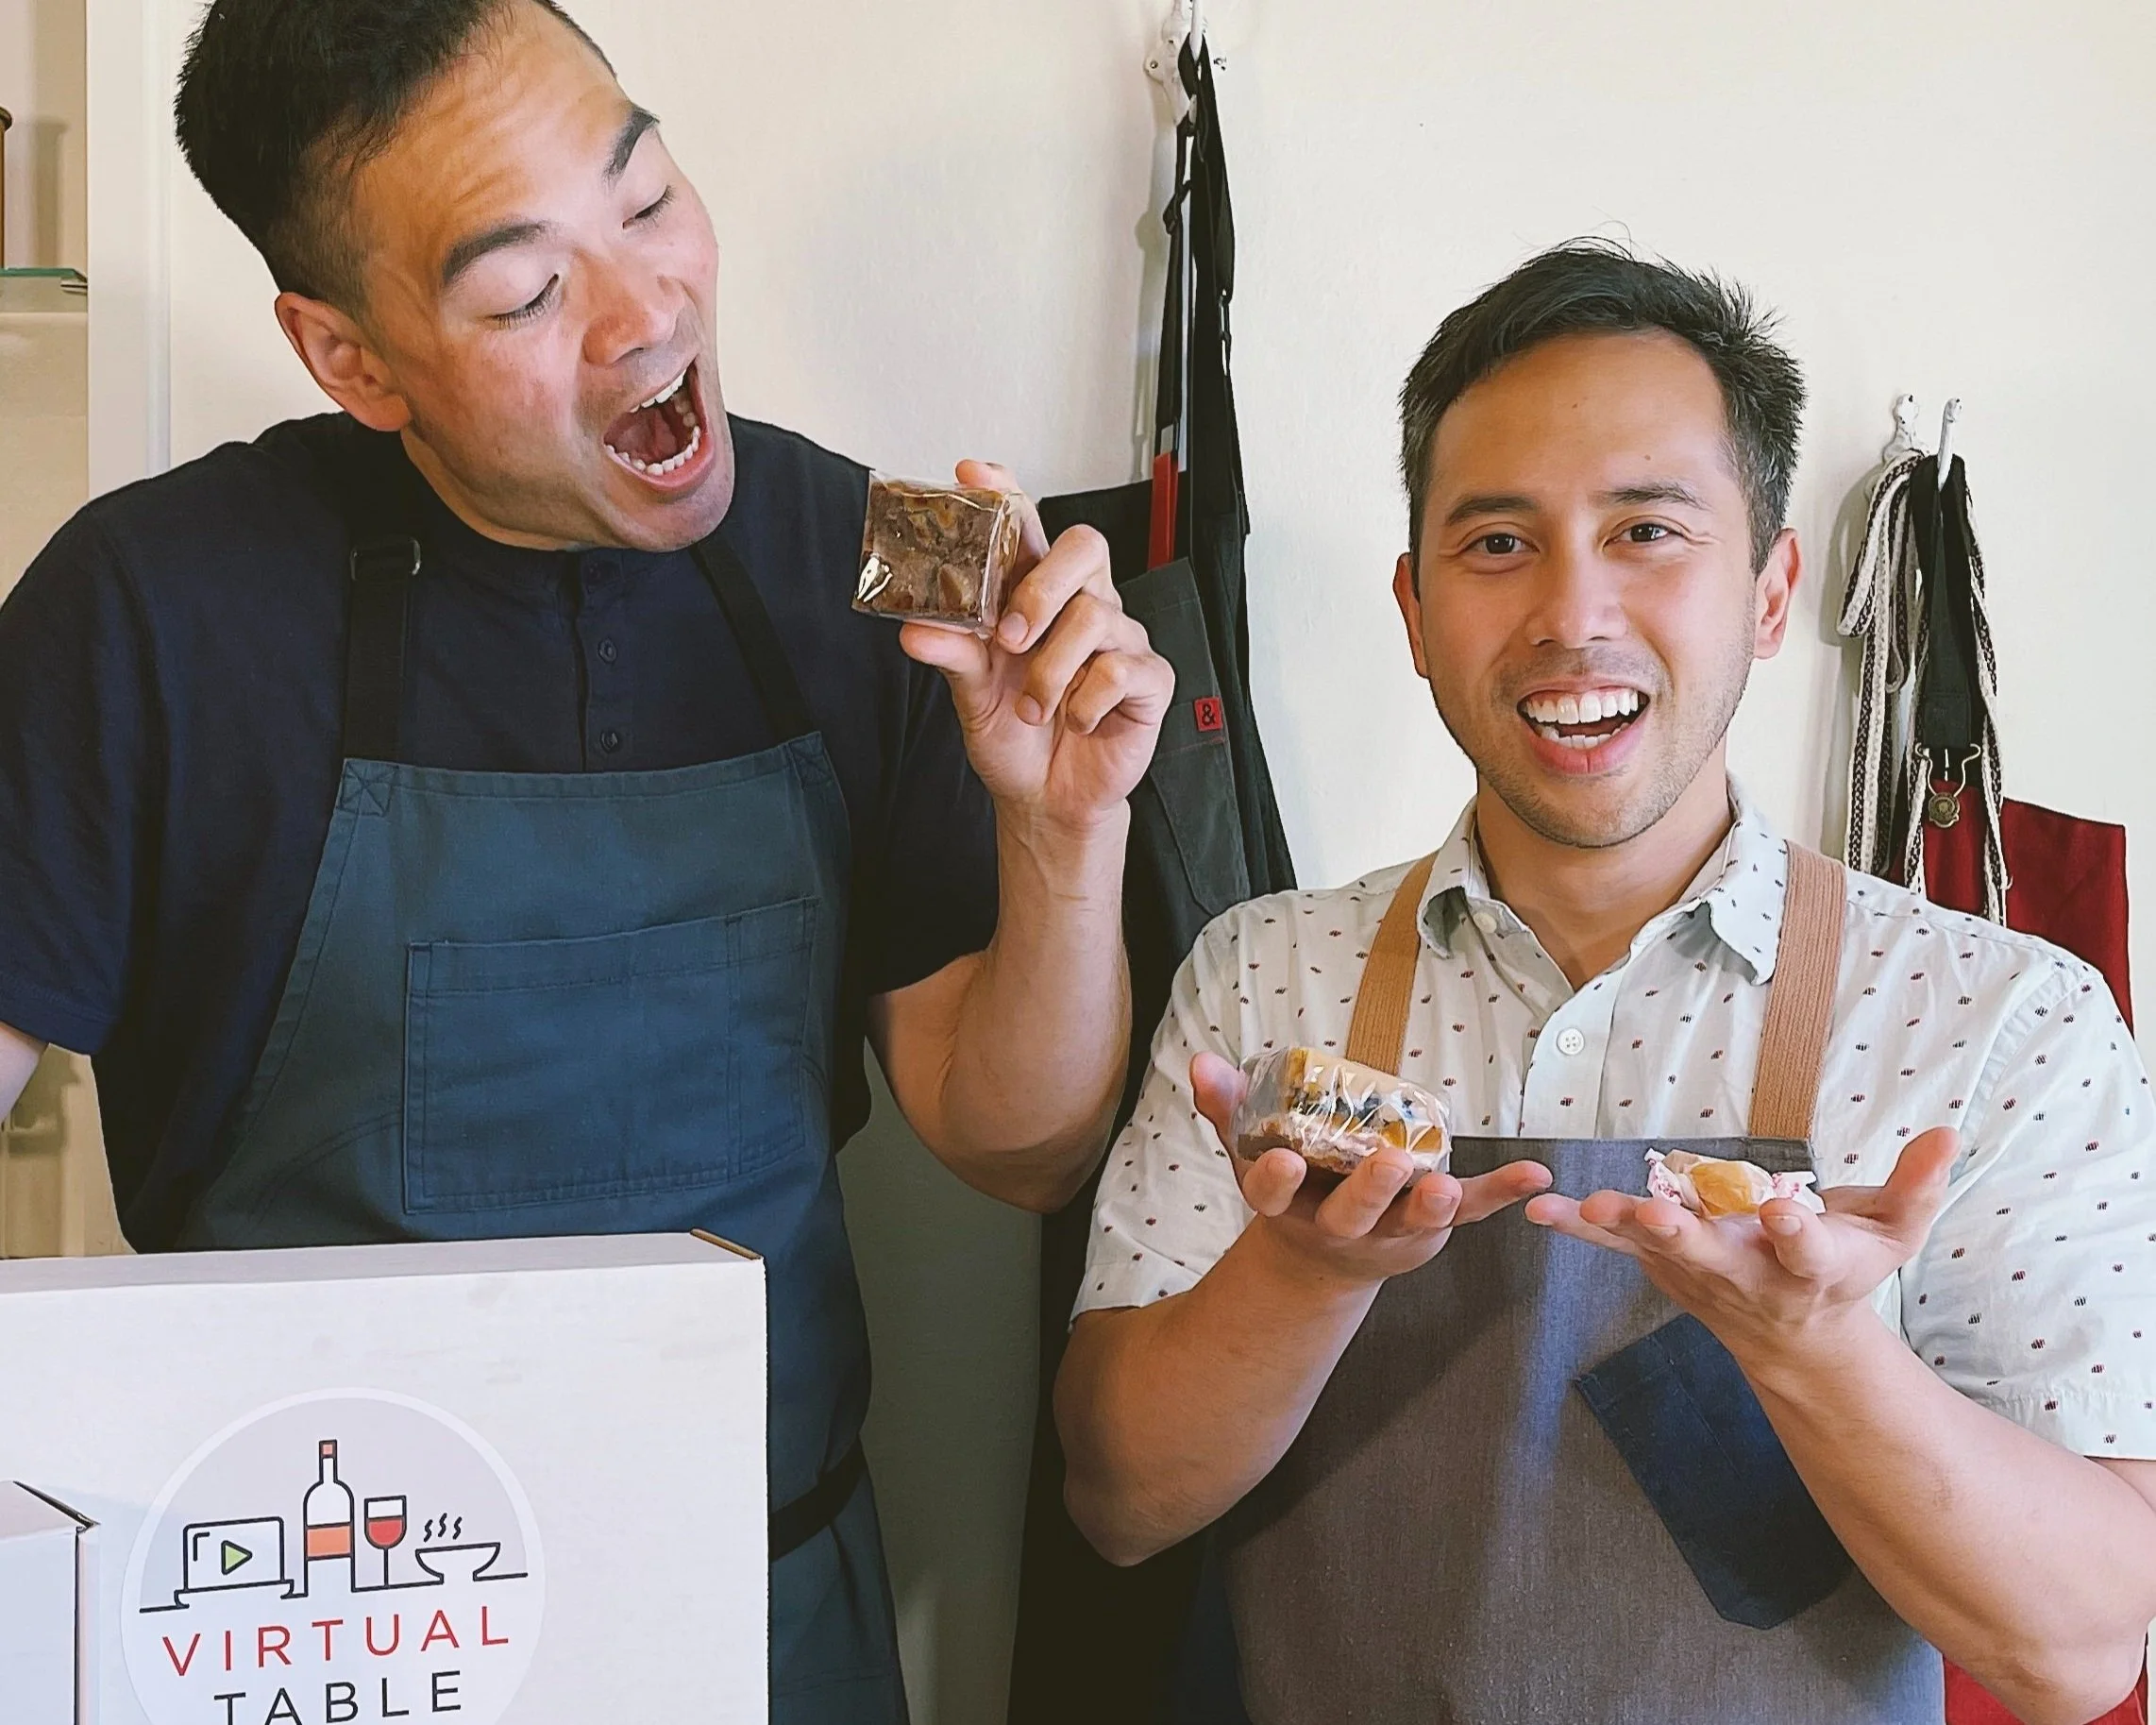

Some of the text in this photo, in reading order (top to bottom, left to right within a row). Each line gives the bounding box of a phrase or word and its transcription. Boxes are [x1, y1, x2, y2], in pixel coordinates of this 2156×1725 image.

[1202, 702, 1215, 726] &
[162, 1606, 509, 1677] VIRTUAL
[214, 1670, 461, 1725] TABLE
